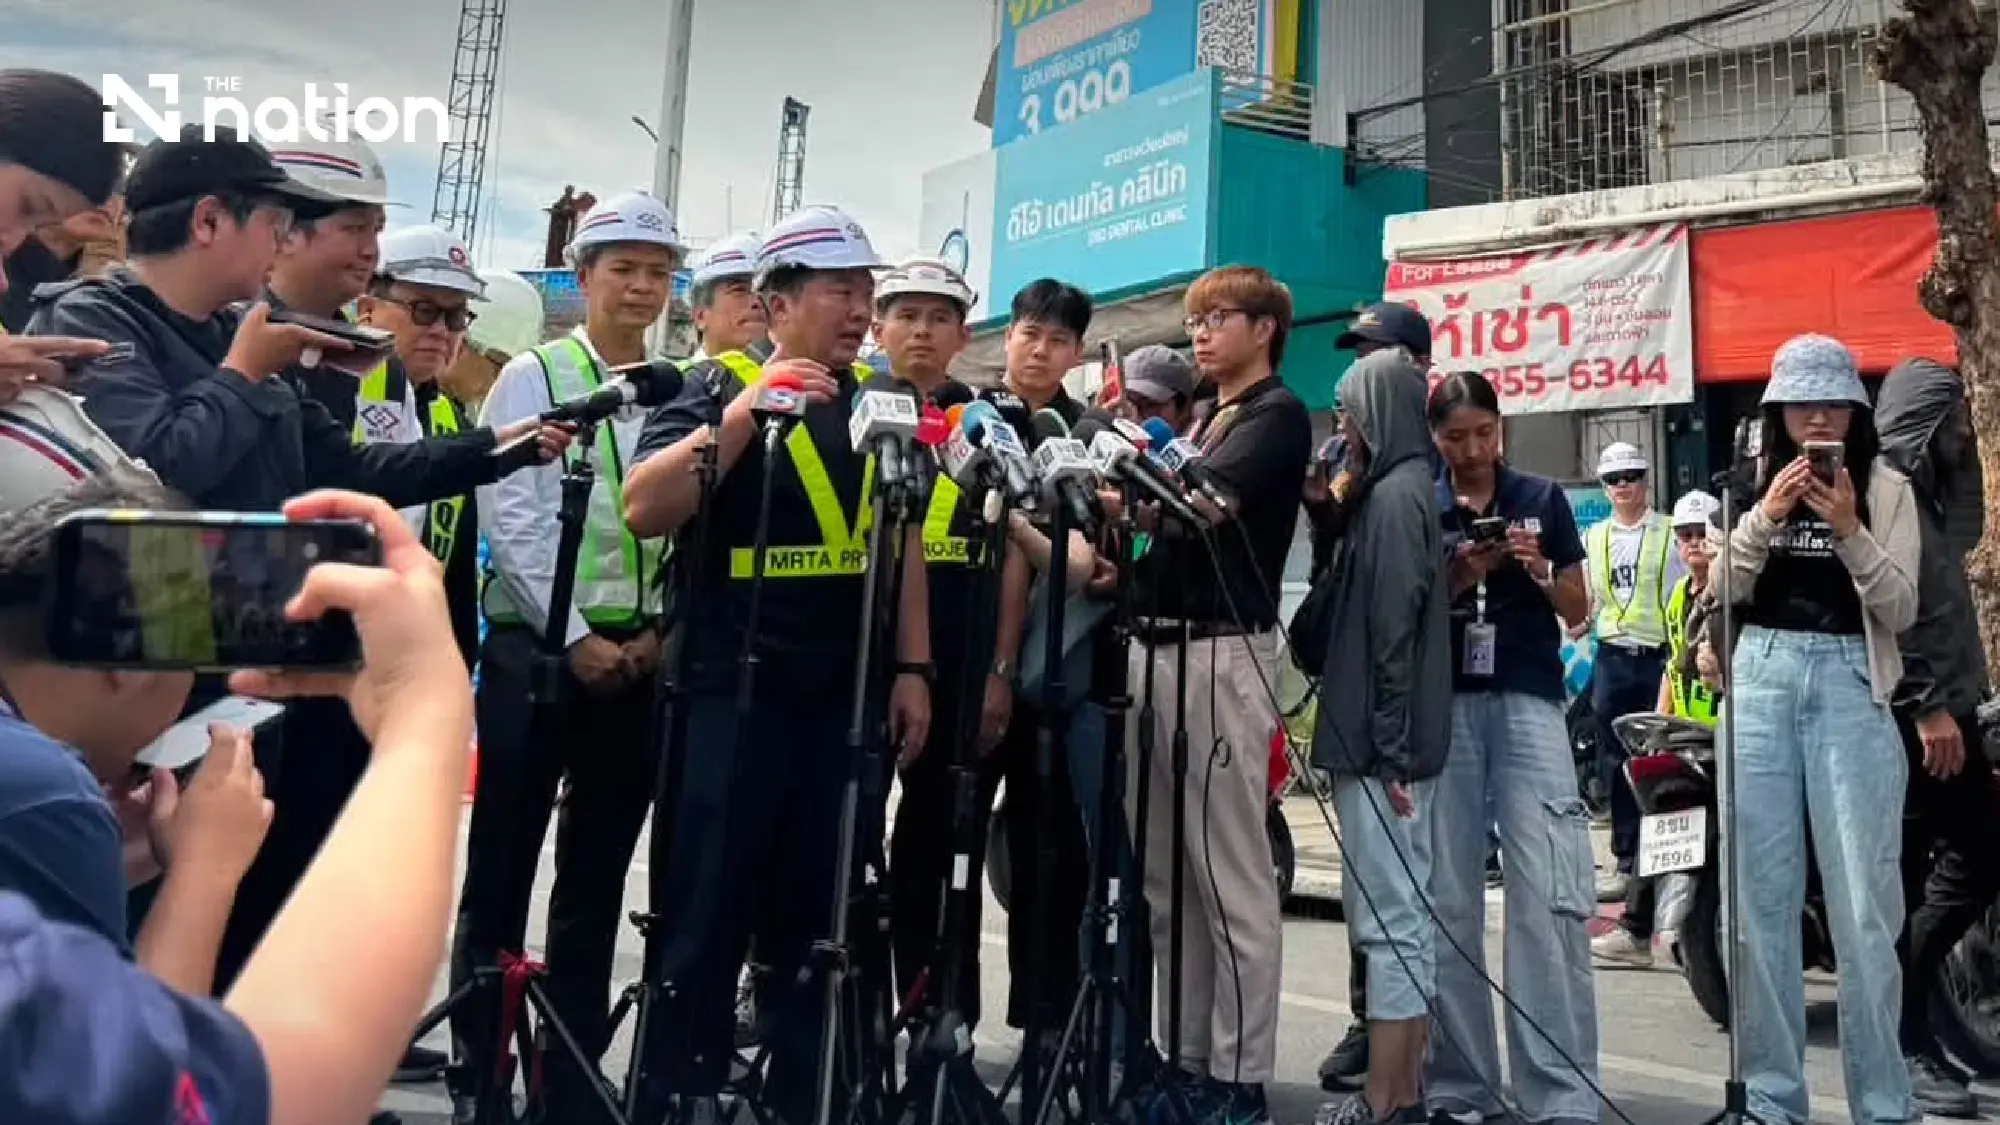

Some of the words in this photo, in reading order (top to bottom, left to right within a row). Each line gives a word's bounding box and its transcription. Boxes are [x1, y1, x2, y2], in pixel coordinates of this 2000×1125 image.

[1121, 160, 1187, 209] คลินิก
[1401, 264, 1437, 284] For
[1404, 284, 1571, 358] ห้เช่า
[770, 551, 833, 570] MRTA
[1649, 849, 1693, 870] 7596
